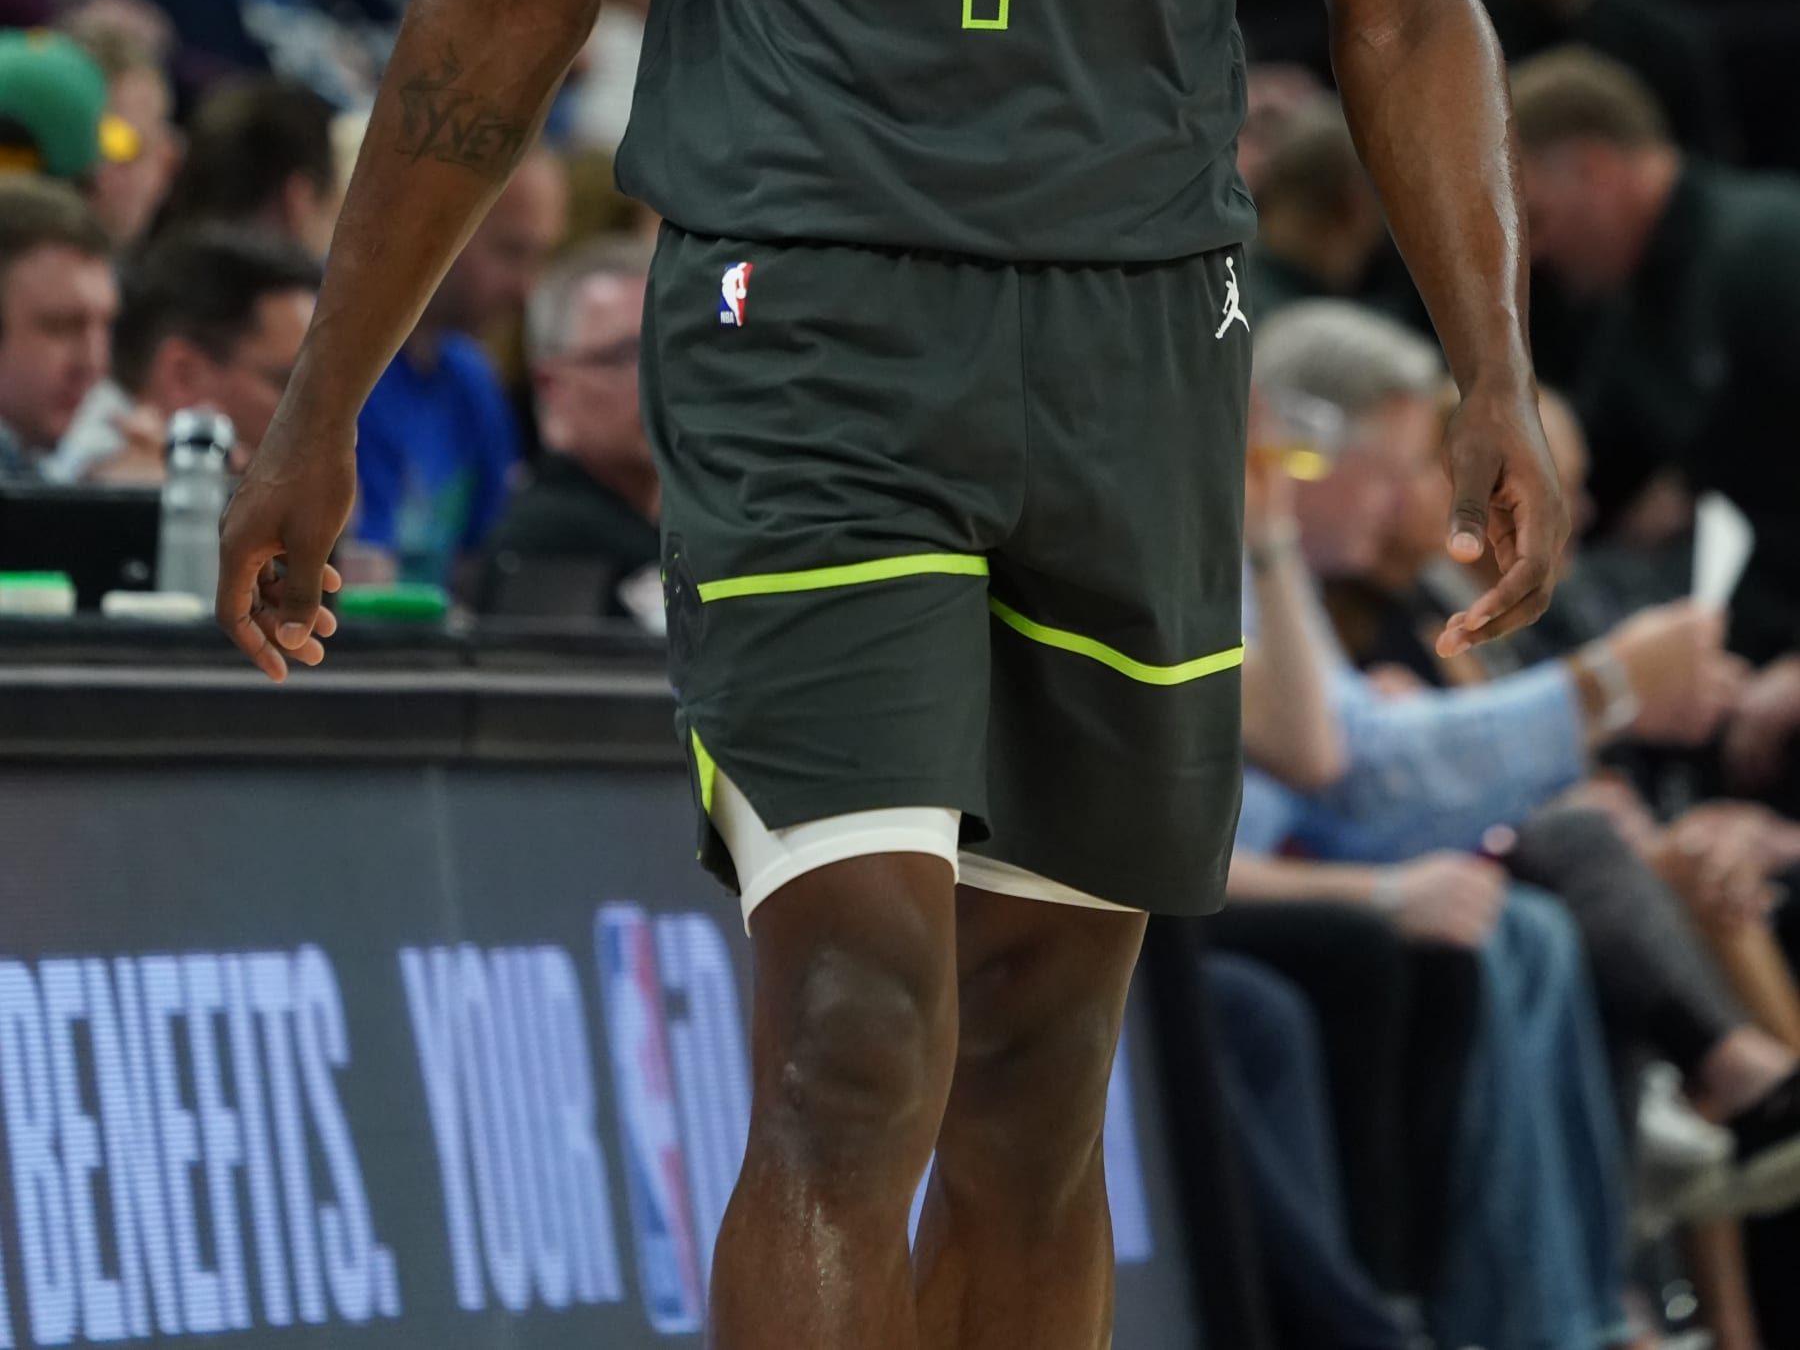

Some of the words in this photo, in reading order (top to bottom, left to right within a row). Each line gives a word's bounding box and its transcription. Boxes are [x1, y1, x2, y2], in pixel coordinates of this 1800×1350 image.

[720, 310, 735, 324] NBA
[0, 942, 401, 1346] BENEFITS.
[398, 941, 627, 1312] YOUR
